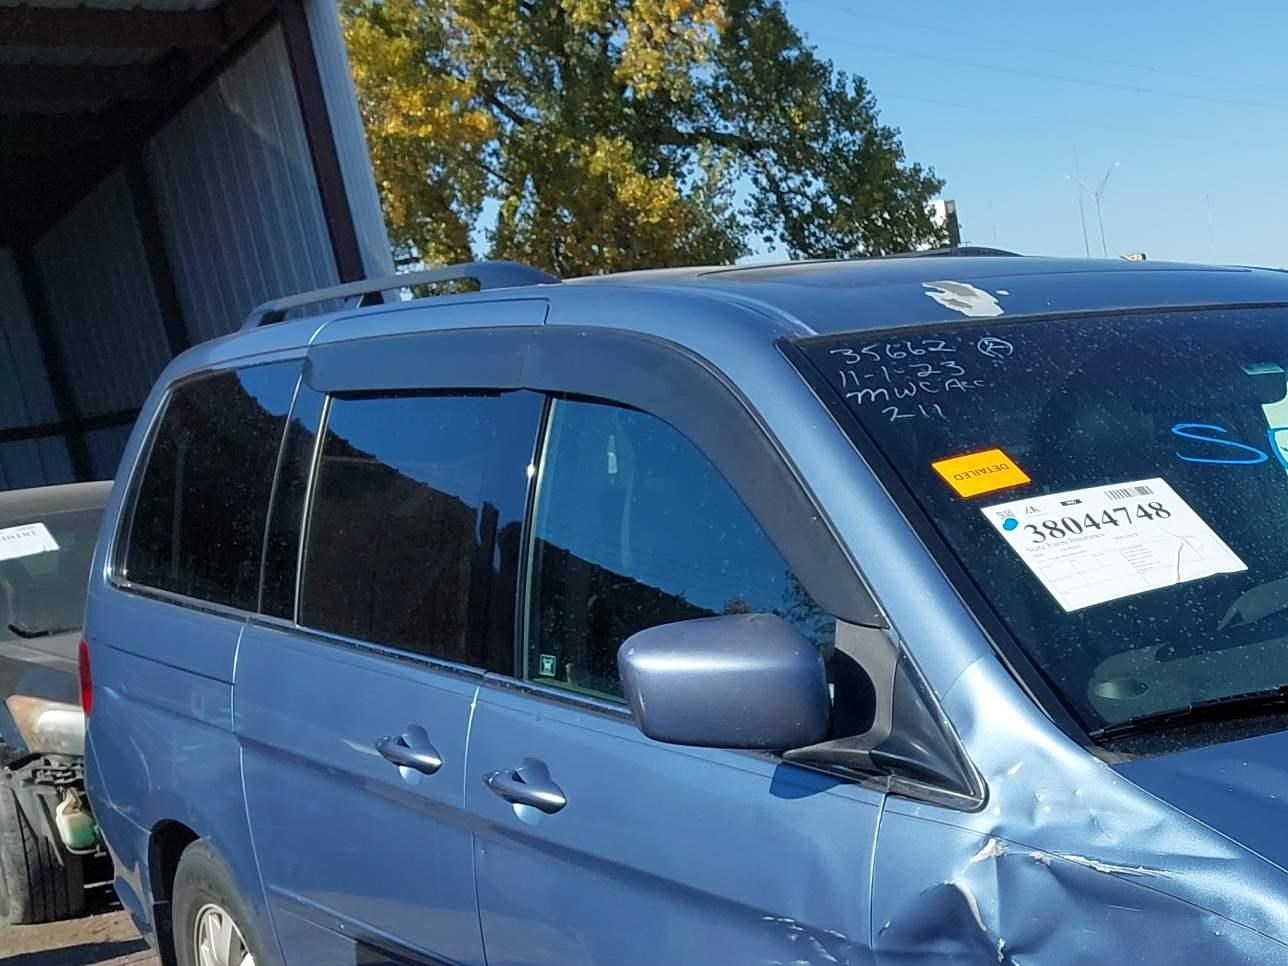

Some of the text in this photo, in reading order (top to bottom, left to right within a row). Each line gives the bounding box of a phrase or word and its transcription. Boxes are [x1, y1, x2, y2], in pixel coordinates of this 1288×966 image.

[830, 339, 956, 365] 35662
[839, 361, 966, 388] 11-1-23
[952, 463, 1011, 481] DETAILED
[1023, 501, 1172, 544] 38044748
